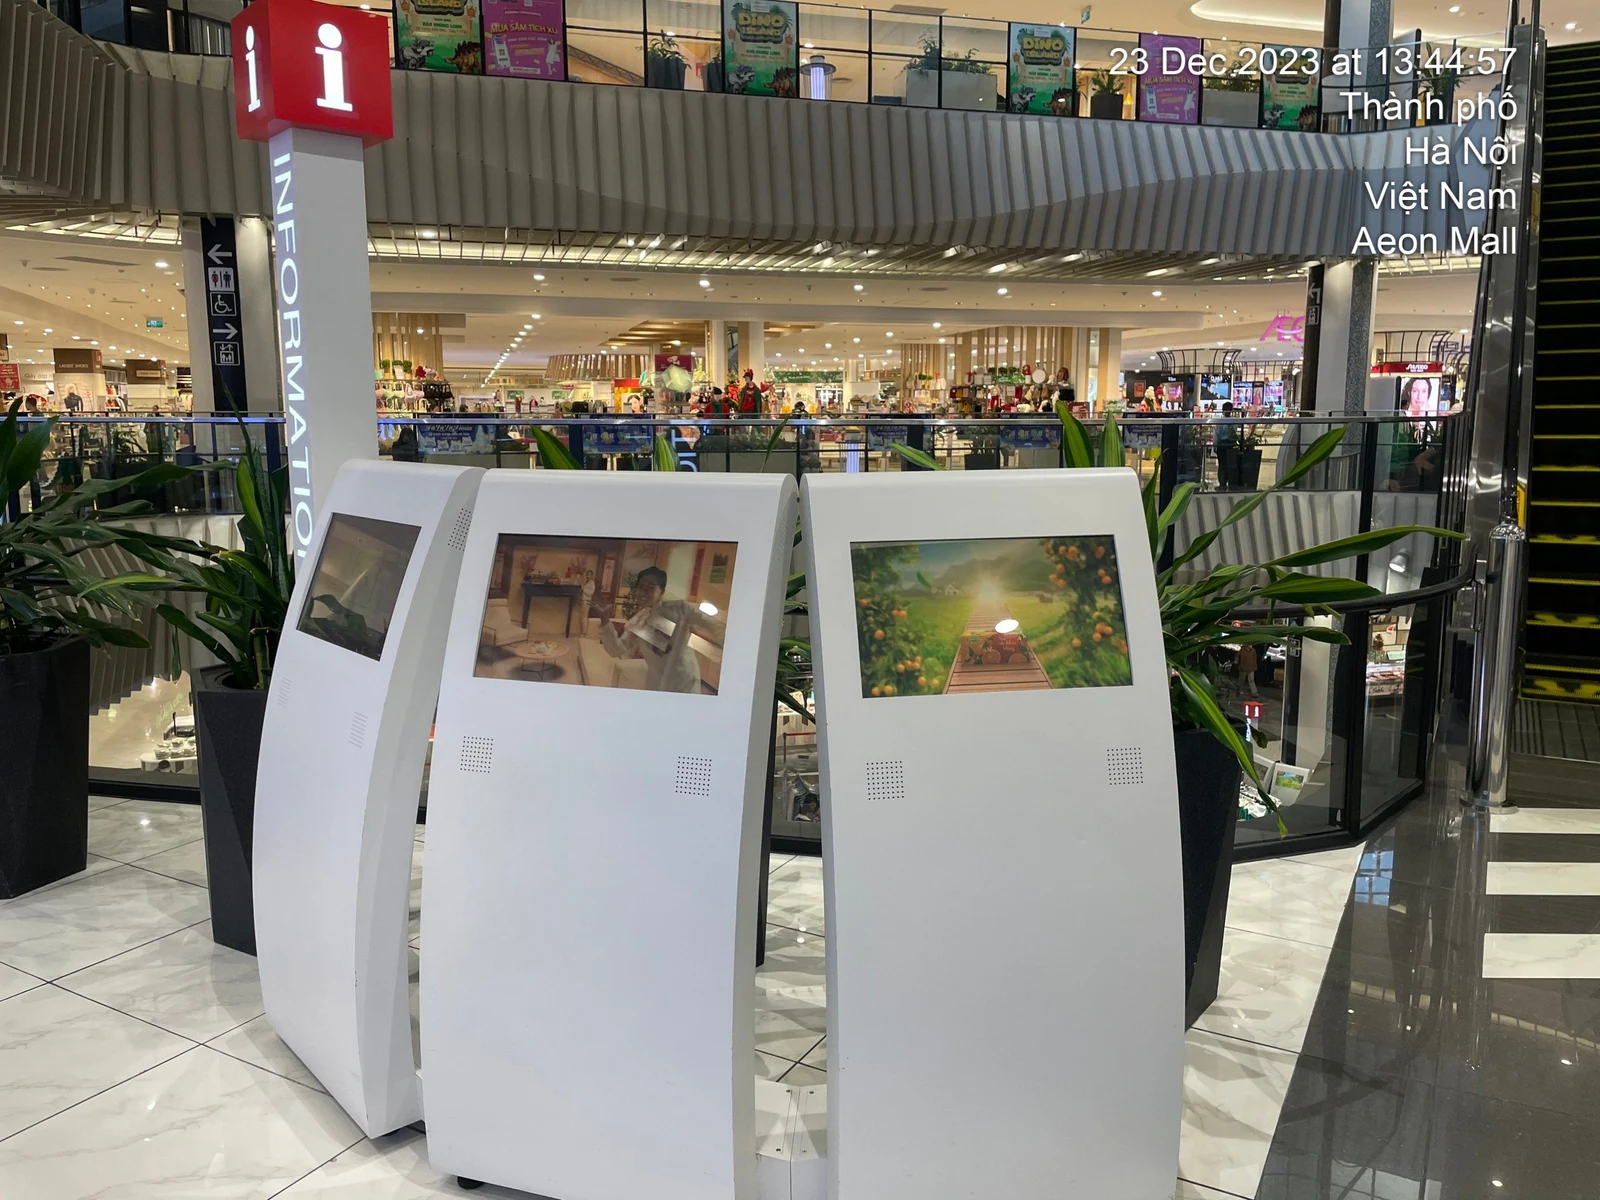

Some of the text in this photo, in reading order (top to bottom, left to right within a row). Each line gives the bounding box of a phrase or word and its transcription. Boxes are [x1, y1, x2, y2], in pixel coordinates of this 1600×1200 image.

[738, 12, 785, 27] DINO
[490, 23, 509, 33] MUA
[1023, 38, 1064, 51] DINO
